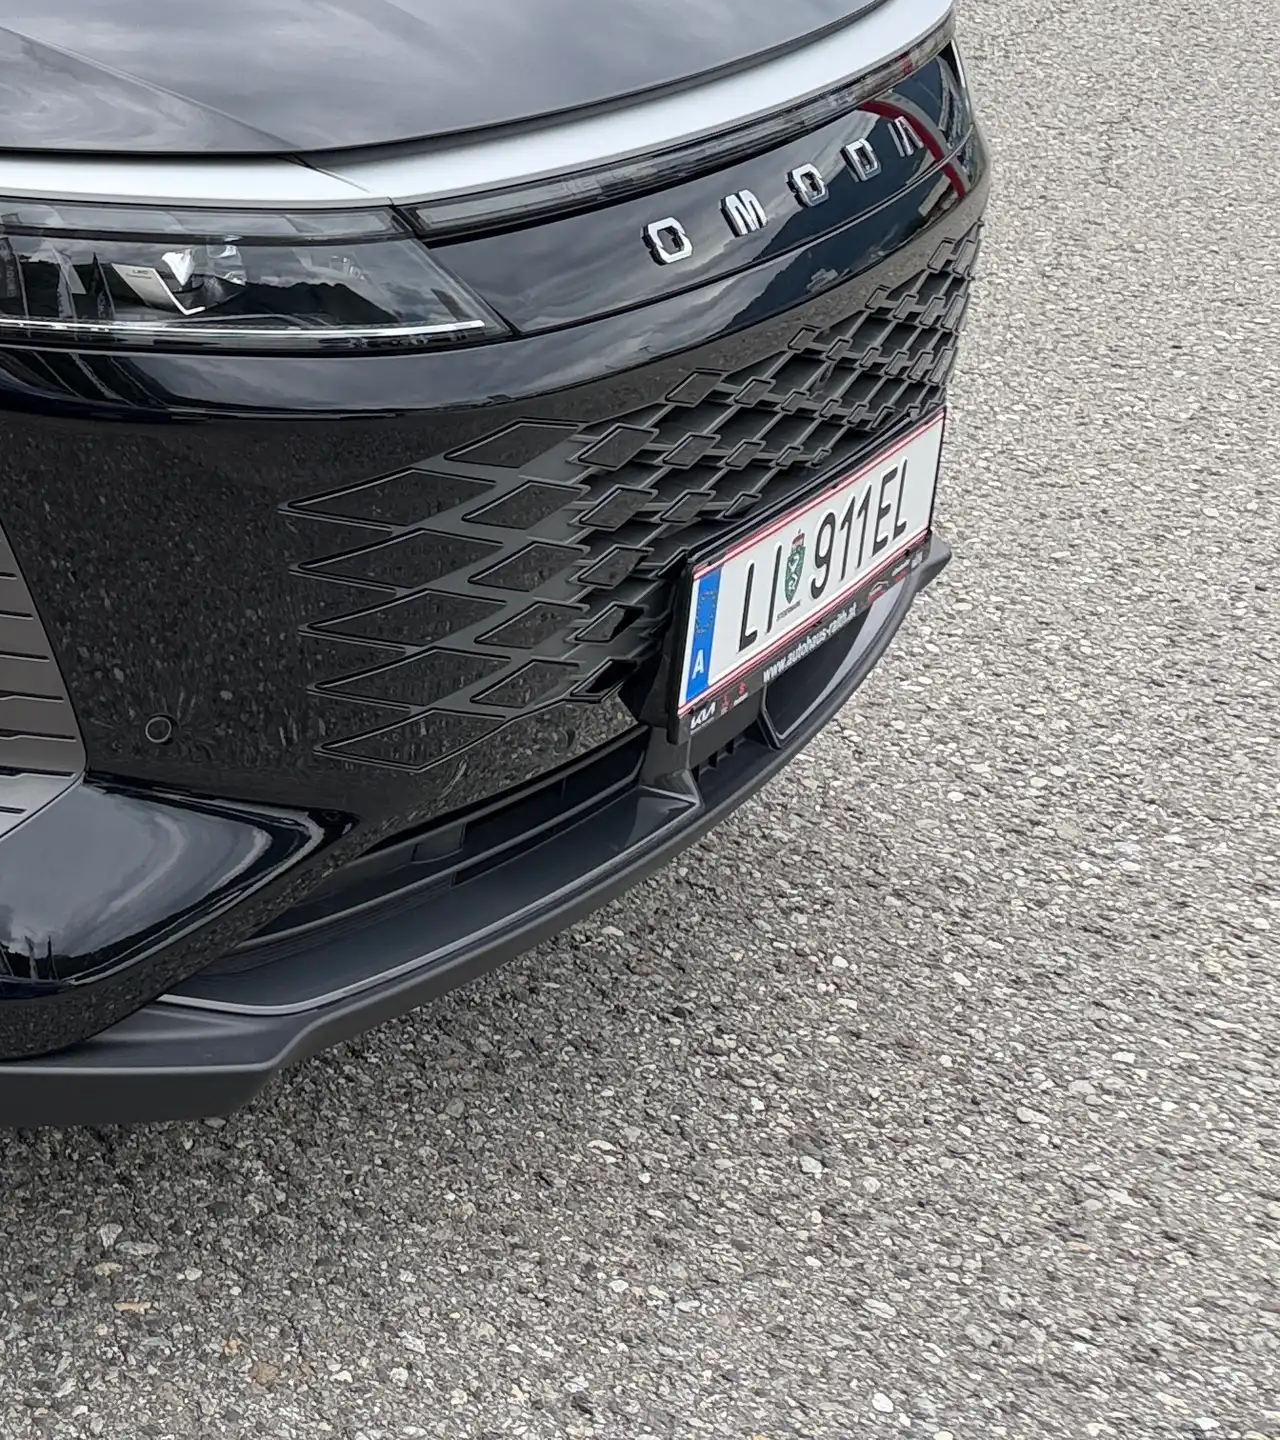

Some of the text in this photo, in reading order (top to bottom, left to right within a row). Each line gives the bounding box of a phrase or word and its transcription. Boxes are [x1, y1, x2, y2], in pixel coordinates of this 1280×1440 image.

[642, 114, 925, 266] OMODA
[737, 549, 783, 655] LI
[810, 462, 909, 600] 911EL
[691, 648, 705, 680] A
[762, 603, 859, 683] www.autohaus-raith.at
